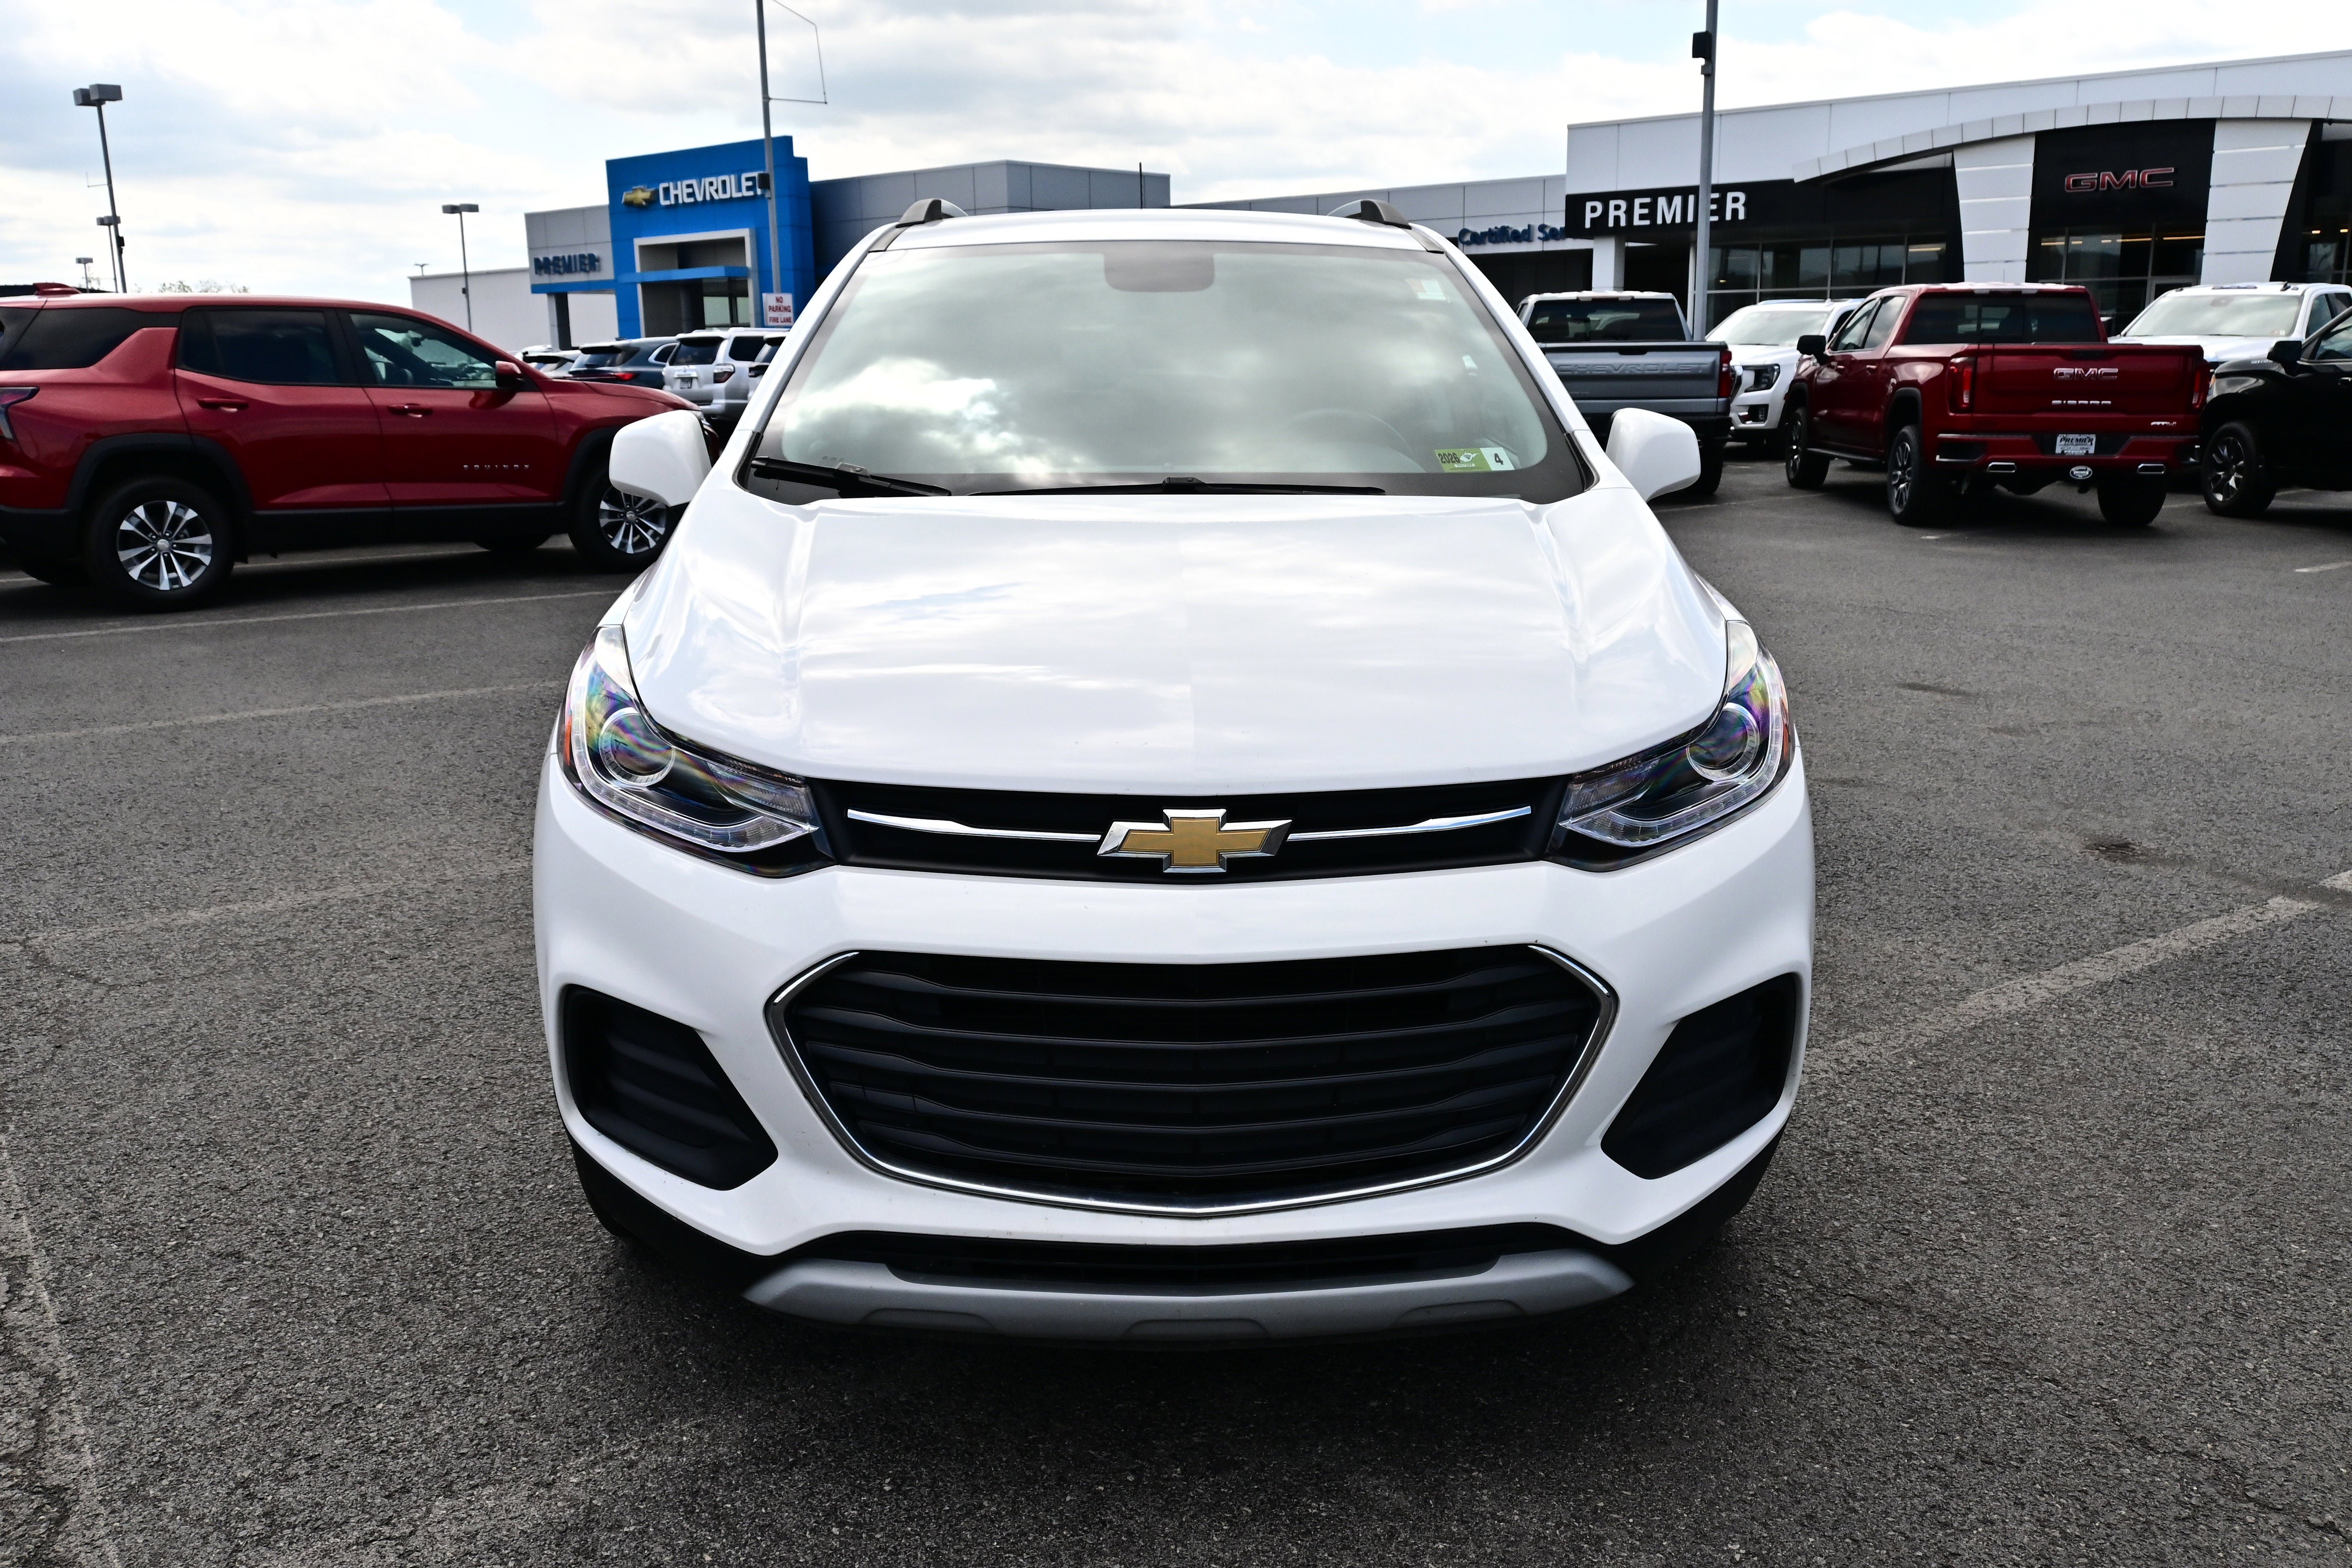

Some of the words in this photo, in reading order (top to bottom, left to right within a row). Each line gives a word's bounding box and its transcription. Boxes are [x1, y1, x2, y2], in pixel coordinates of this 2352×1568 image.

[659, 171, 765, 206] CHEVROLET
[2065, 167, 2174, 192] GMC
[1585, 191, 1746, 229] PREMIER
[1459, 224, 1533, 245] Certified
[534, 253, 600, 275] PREMIER
[1557, 363, 1708, 374] CHEVROLET
[2053, 368, 2118, 380] GMC
[1438, 453, 1460, 463] 2026
[1494, 453, 1503, 465] 4
